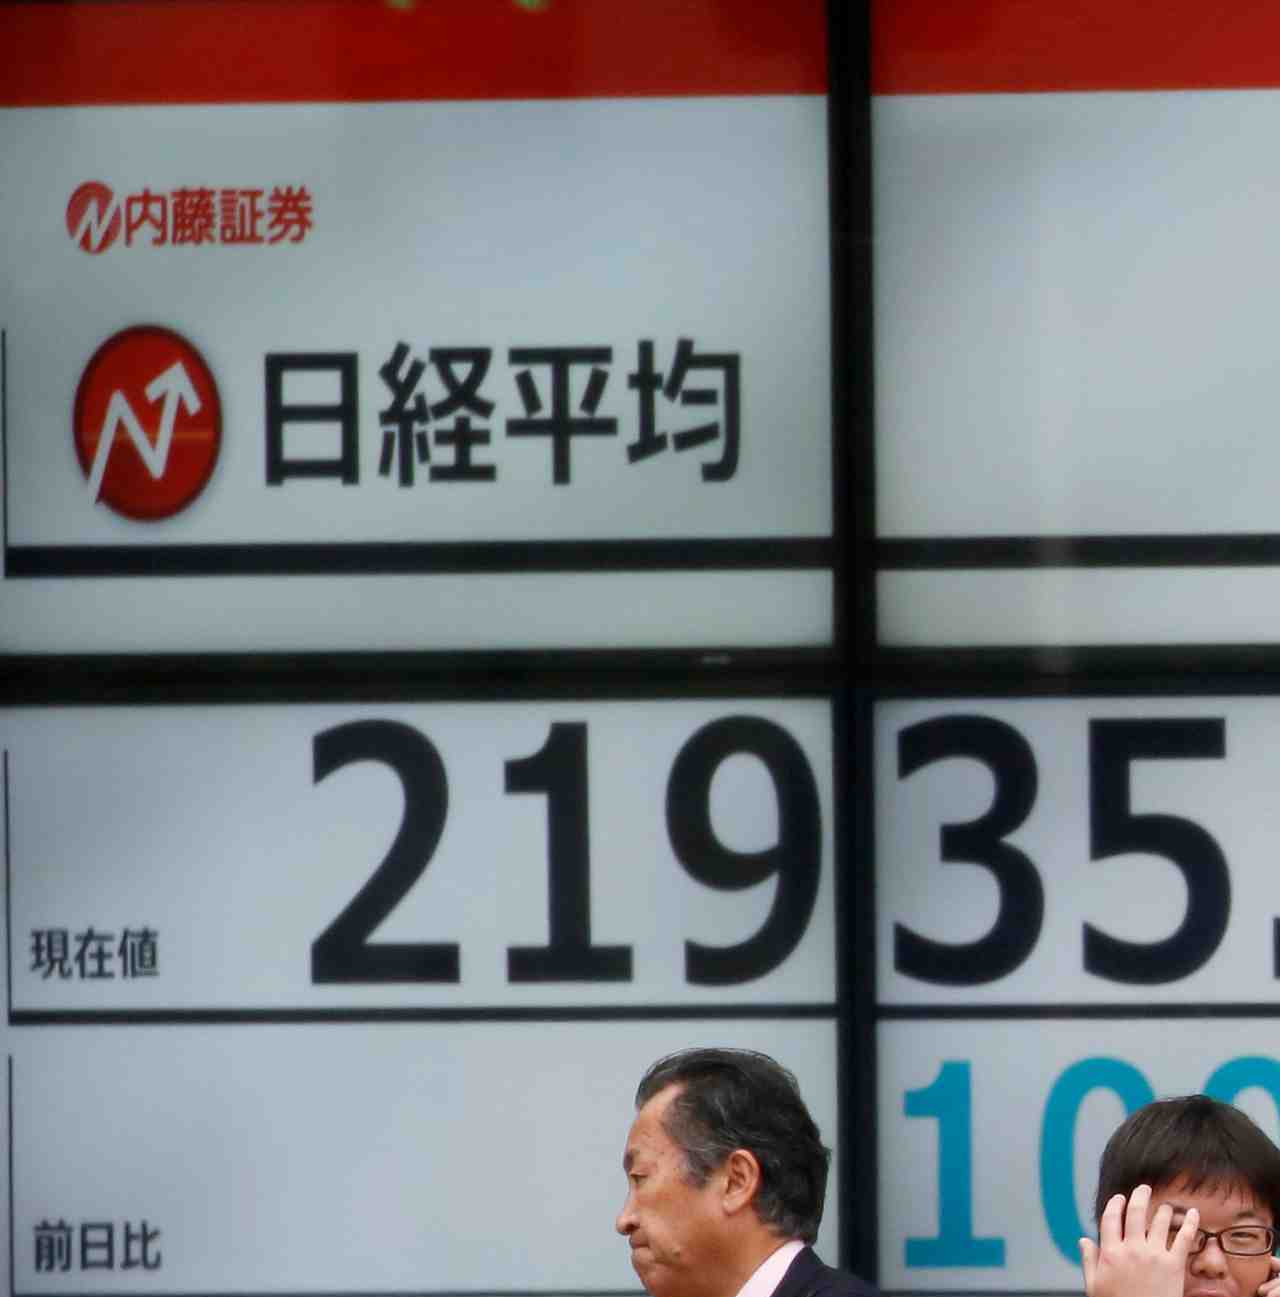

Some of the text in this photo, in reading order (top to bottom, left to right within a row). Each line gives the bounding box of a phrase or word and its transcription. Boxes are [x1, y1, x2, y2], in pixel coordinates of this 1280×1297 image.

[124, 187, 313, 246] 内藤証券
[264, 338, 742, 488] 日経平均
[29, 927, 160, 981] 現在値
[33, 1219, 162, 1274] 前日比
